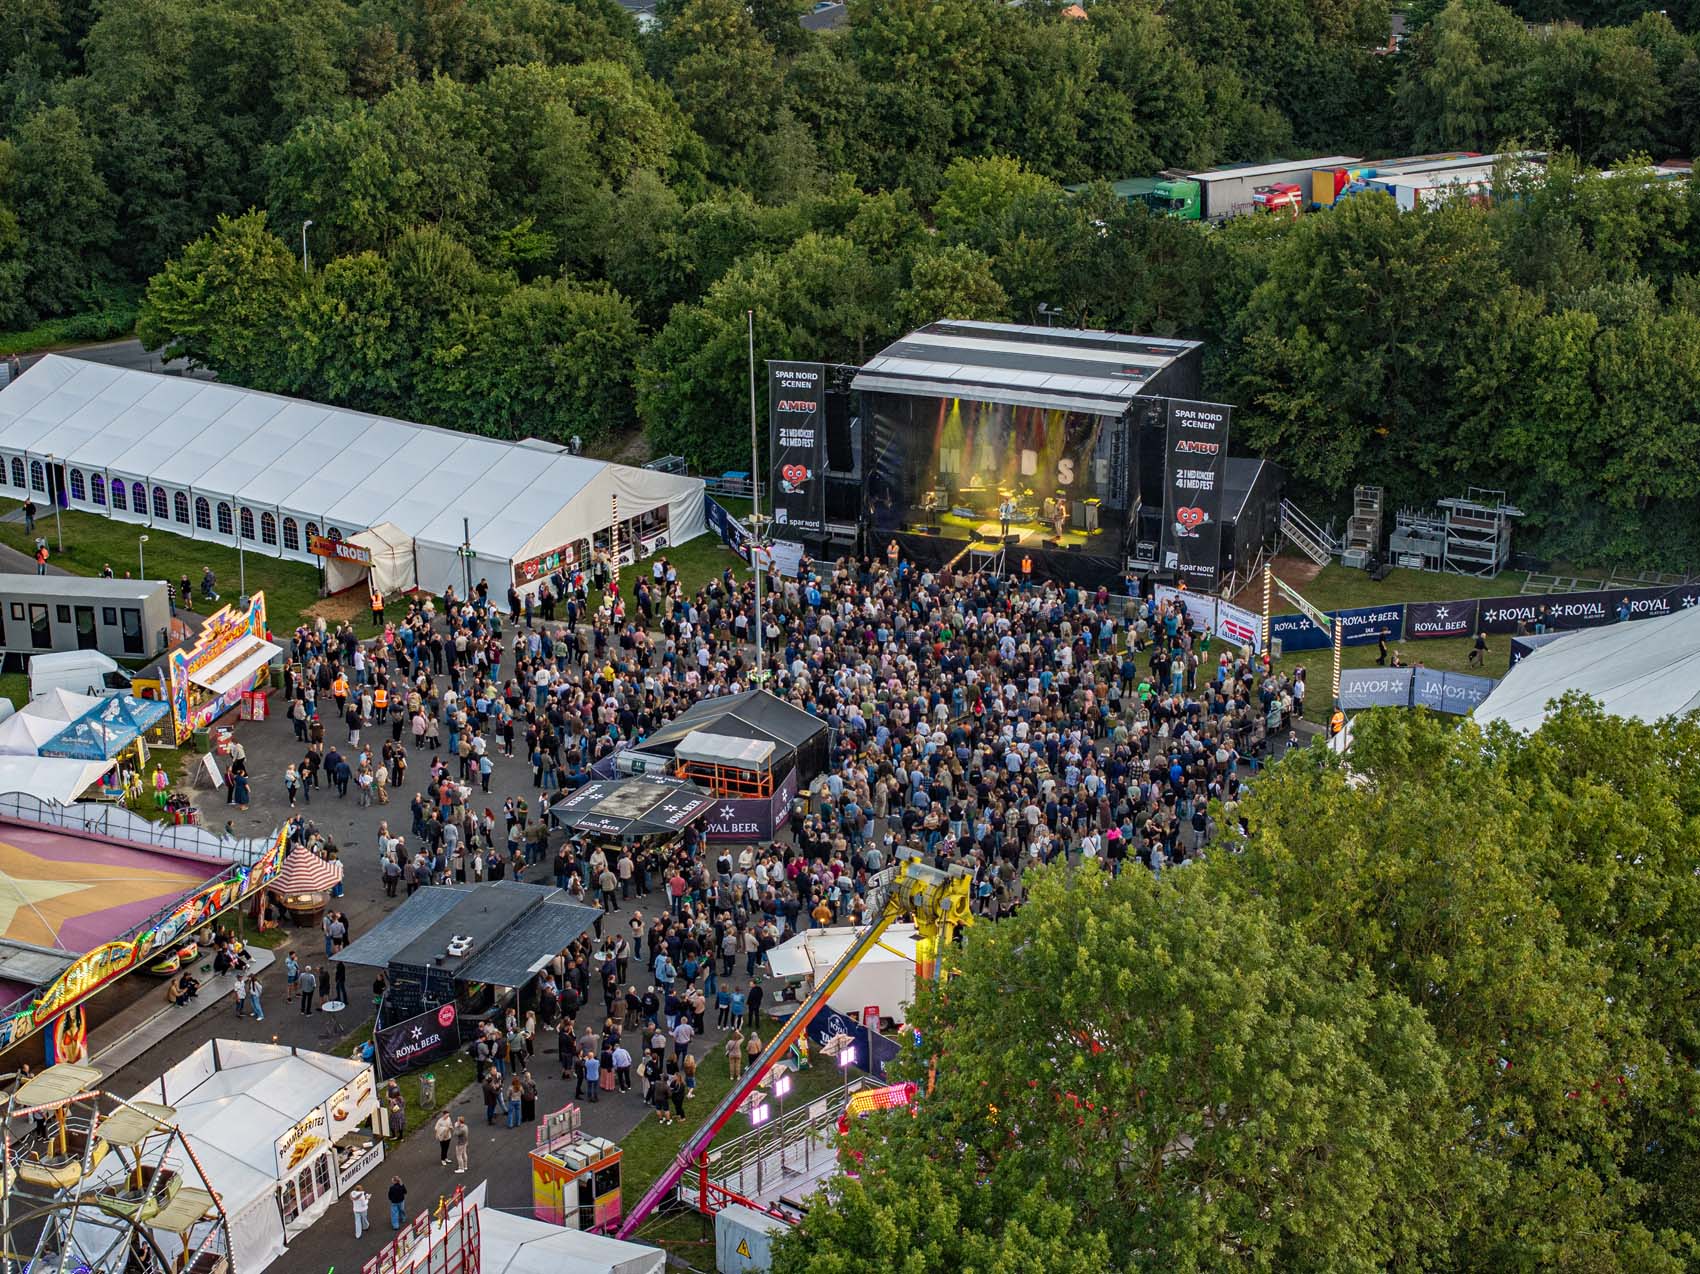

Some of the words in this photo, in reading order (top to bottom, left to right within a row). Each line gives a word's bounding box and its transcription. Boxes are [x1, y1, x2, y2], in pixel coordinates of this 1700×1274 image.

[776, 371, 794, 379] SPAR
[796, 372, 818, 380] NORD
[781, 381, 812, 389] SCENEN
[777, 400, 817, 413] AMBU
[1175, 410, 1196, 419] SPAR
[1198, 412, 1222, 421] NORD
[1181, 420, 1215, 430] SCENEN
[1175, 440, 1219, 455] AMBU
[1200, 480, 1214, 490] FEST
[336, 544, 369, 561] KROEN
[1565, 602, 1605, 616] ROYAL
[1631, 599, 1670, 612] ROYAL
[1342, 615, 1368, 626] ROYAL
[1377, 611, 1400, 622] BEER
[1274, 622, 1298, 631] ROYAL
[1414, 622, 1443, 631] ROYAL
[1445, 620, 1468, 630] BEER
[580, 820, 601, 829] ROYAL
[706, 823, 729, 833] OYAL
[731, 823, 760, 833] BEER
[396, 1043, 420, 1058] ROYAL
[421, 1033, 440, 1048] BEER
[279, 1126, 304, 1159] POMMES
[304, 1116, 325, 1132] FRITES
[341, 1162, 361, 1185] POMMES
[362, 1147, 379, 1168] FRITES
